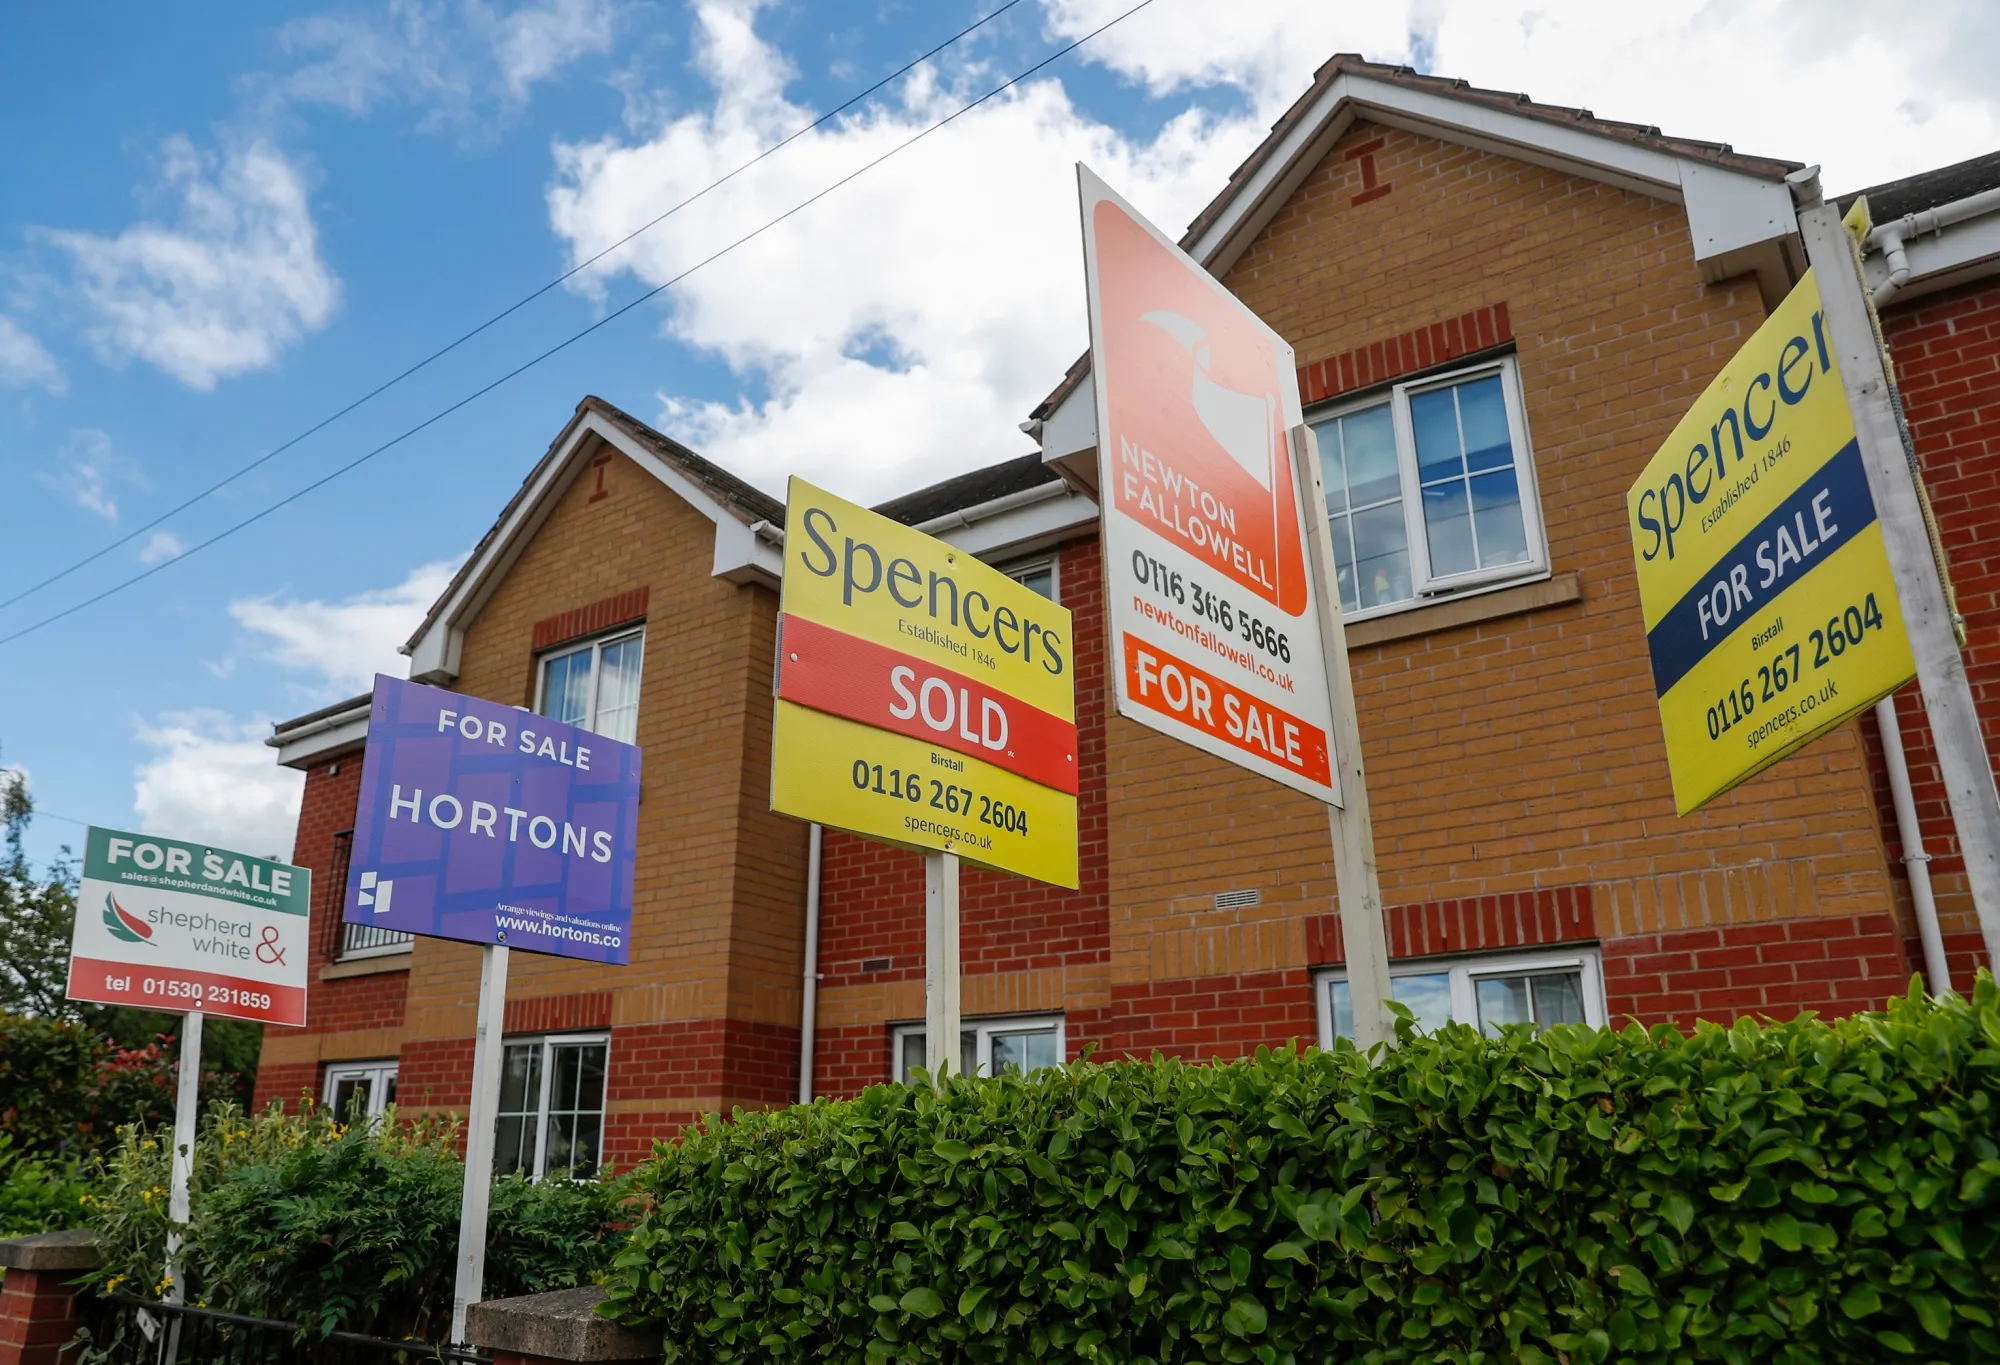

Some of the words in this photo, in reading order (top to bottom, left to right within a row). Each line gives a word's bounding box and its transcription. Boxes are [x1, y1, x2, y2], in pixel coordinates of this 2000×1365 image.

[1637, 308, 1831, 562] Spencer
[1121, 435, 1236, 535] NEWTON
[1700, 469, 1761, 534] Established
[1762, 434, 1792, 473] 1846
[1124, 473, 1274, 591] FALLOWELL
[1697, 564, 1752, 641] FOR
[1755, 487, 1838, 588] SALE
[800, 508, 1063, 675] Spencers
[1132, 549, 1185, 605] 0116
[1238, 609, 1291, 664] 5666
[898, 618, 968, 658] Established
[971, 648, 996, 670] 1846
[1133, 595, 1295, 694] newtonfallowell.co.uk
[1706, 677, 1754, 742] 0116
[1757, 644, 1800, 701] 267
[1808, 592, 1883, 670] 2604
[1751, 616, 1784, 653] Birstall
[437, 709, 507, 747] FOR
[519, 730, 592, 771] SALE
[888, 665, 1009, 751] SOLD
[1137, 648, 1214, 728] FOR
[1224, 694, 1303, 767] SALE
[1746, 677, 1838, 749] spencers.co.uk
[852, 759, 921, 803] 0116
[929, 779, 973, 816] 267
[979, 796, 1028, 837] 2604
[931, 752, 964, 773] Birstall
[389, 784, 612, 863] HORTONS
[904, 814, 993, 851] spencers.co.uk
[108, 838, 192, 876] FOR
[202, 855, 292, 896] SALE
[121, 870, 277, 906] sales@shepherdandwhite.co.uk
[148, 907, 251, 938] shepherd
[193, 936, 250, 960] white
[256, 926, 286, 966] &
[495, 915, 621, 948] www.hortons.co
[496, 902, 525, 915] Arrange
[525, 908, 554, 921] viewings
[554, 914, 568, 922] and
[568, 916, 600, 928] valuations
[601, 924, 622, 933] online
[105, 975, 131, 991] tel
[143, 978, 202, 999] 01530
[208, 986, 271, 1009] 231859
